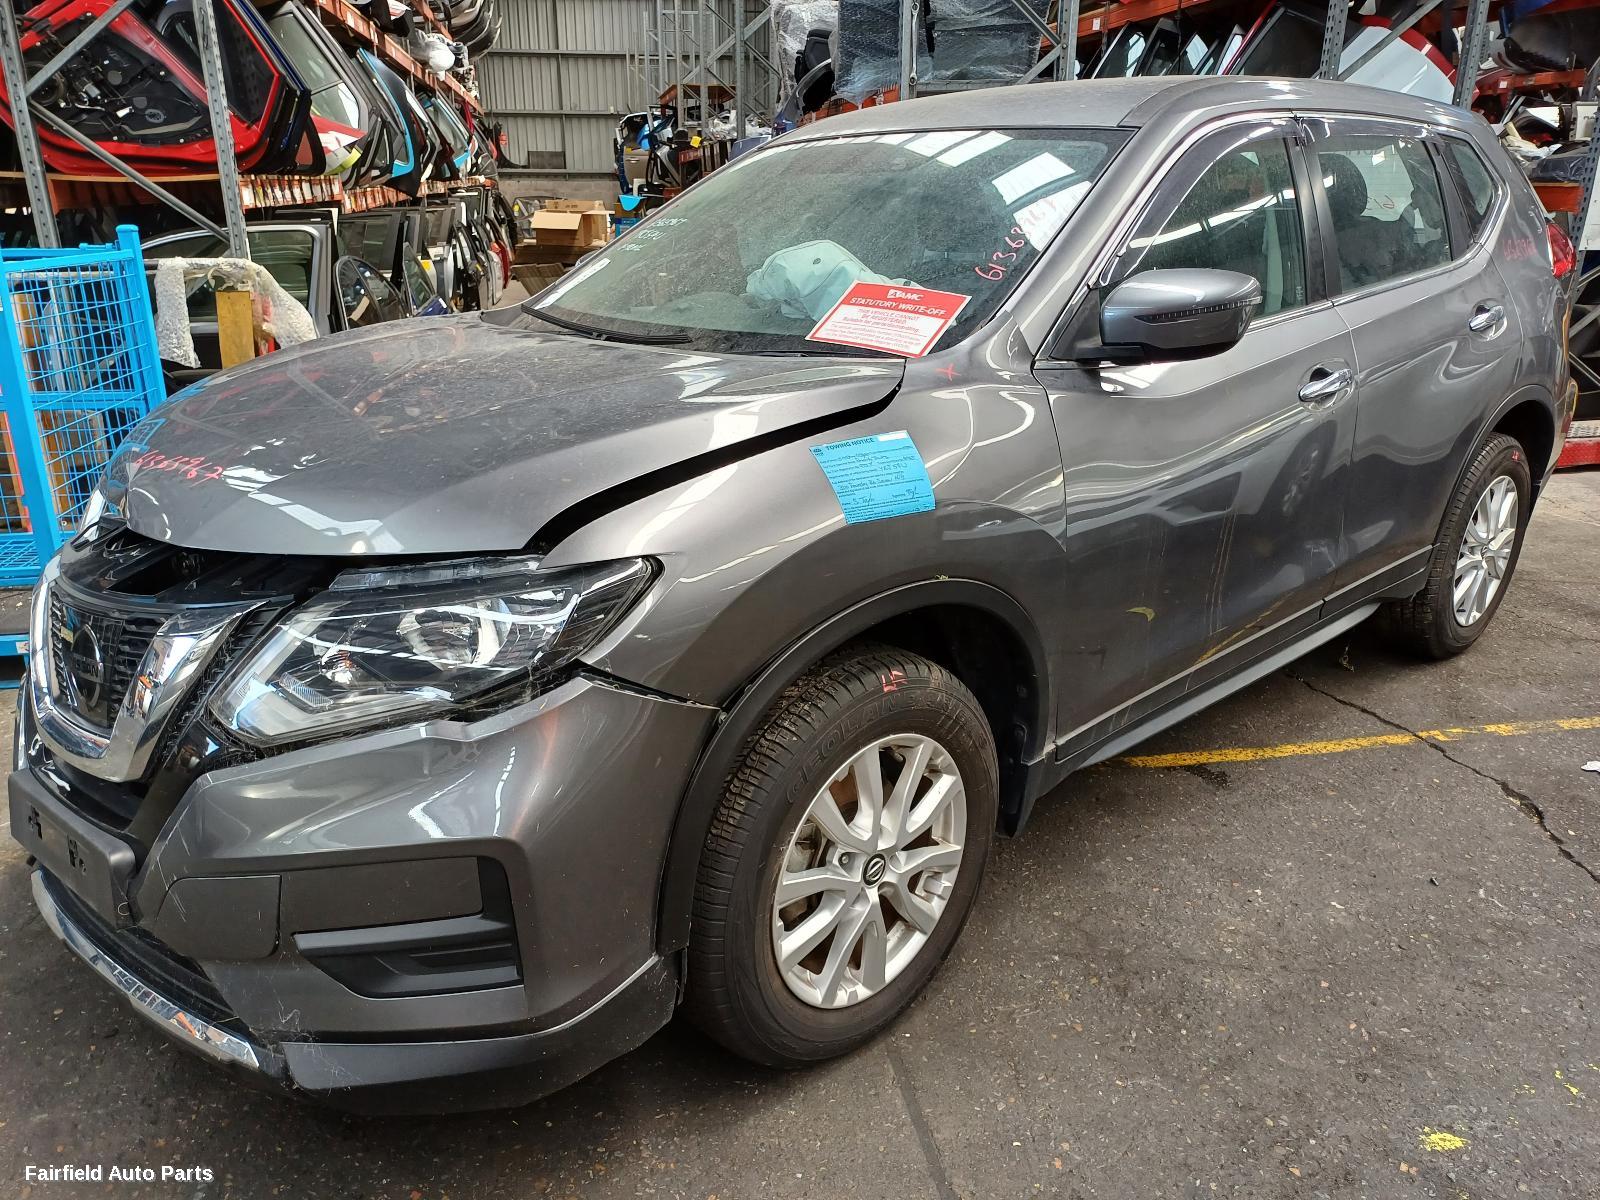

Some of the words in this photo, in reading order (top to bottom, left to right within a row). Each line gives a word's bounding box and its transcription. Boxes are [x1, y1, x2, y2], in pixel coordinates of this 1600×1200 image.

[897, 291, 925, 302] AMC
[850, 297, 899, 308] STATUTORY
[899, 302, 947, 316] WRITE-OFF
[825, 440, 851, 451] TOWING
[851, 437, 875, 447] NOTICE
